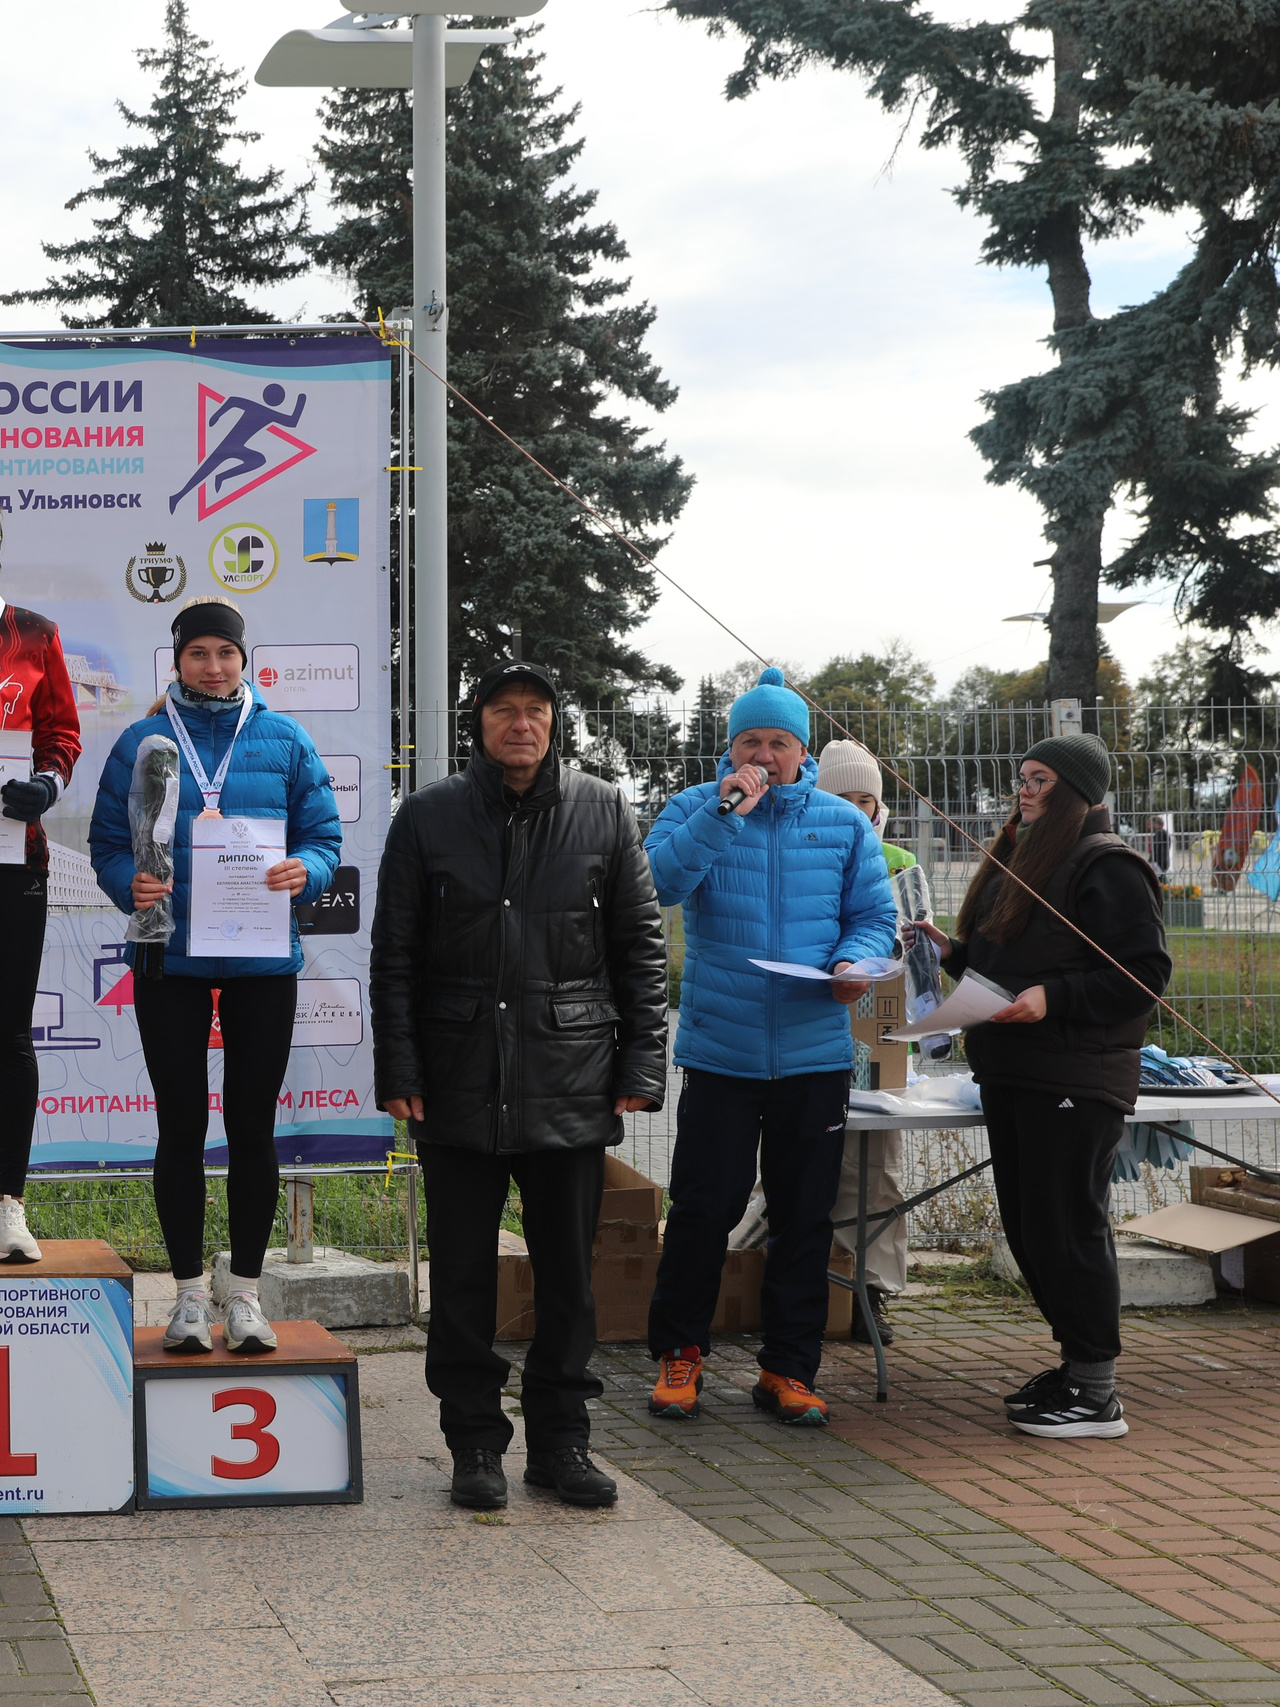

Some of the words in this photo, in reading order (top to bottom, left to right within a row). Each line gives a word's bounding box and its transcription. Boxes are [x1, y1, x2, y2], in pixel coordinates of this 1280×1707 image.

[17, 488, 142, 510] Ульяновск
[139, 557, 173, 565] ТРИУМФ
[223, 574, 264, 583] УЛСПОРТ
[284, 663, 354, 681] azimut
[217, 854, 265, 864] ДИПЛОМ
[298, 1089, 359, 1108] ЛЕСА
[18, 1322, 90, 1336] ОБЛАСТИ
[210, 1386, 281, 1480] 3
